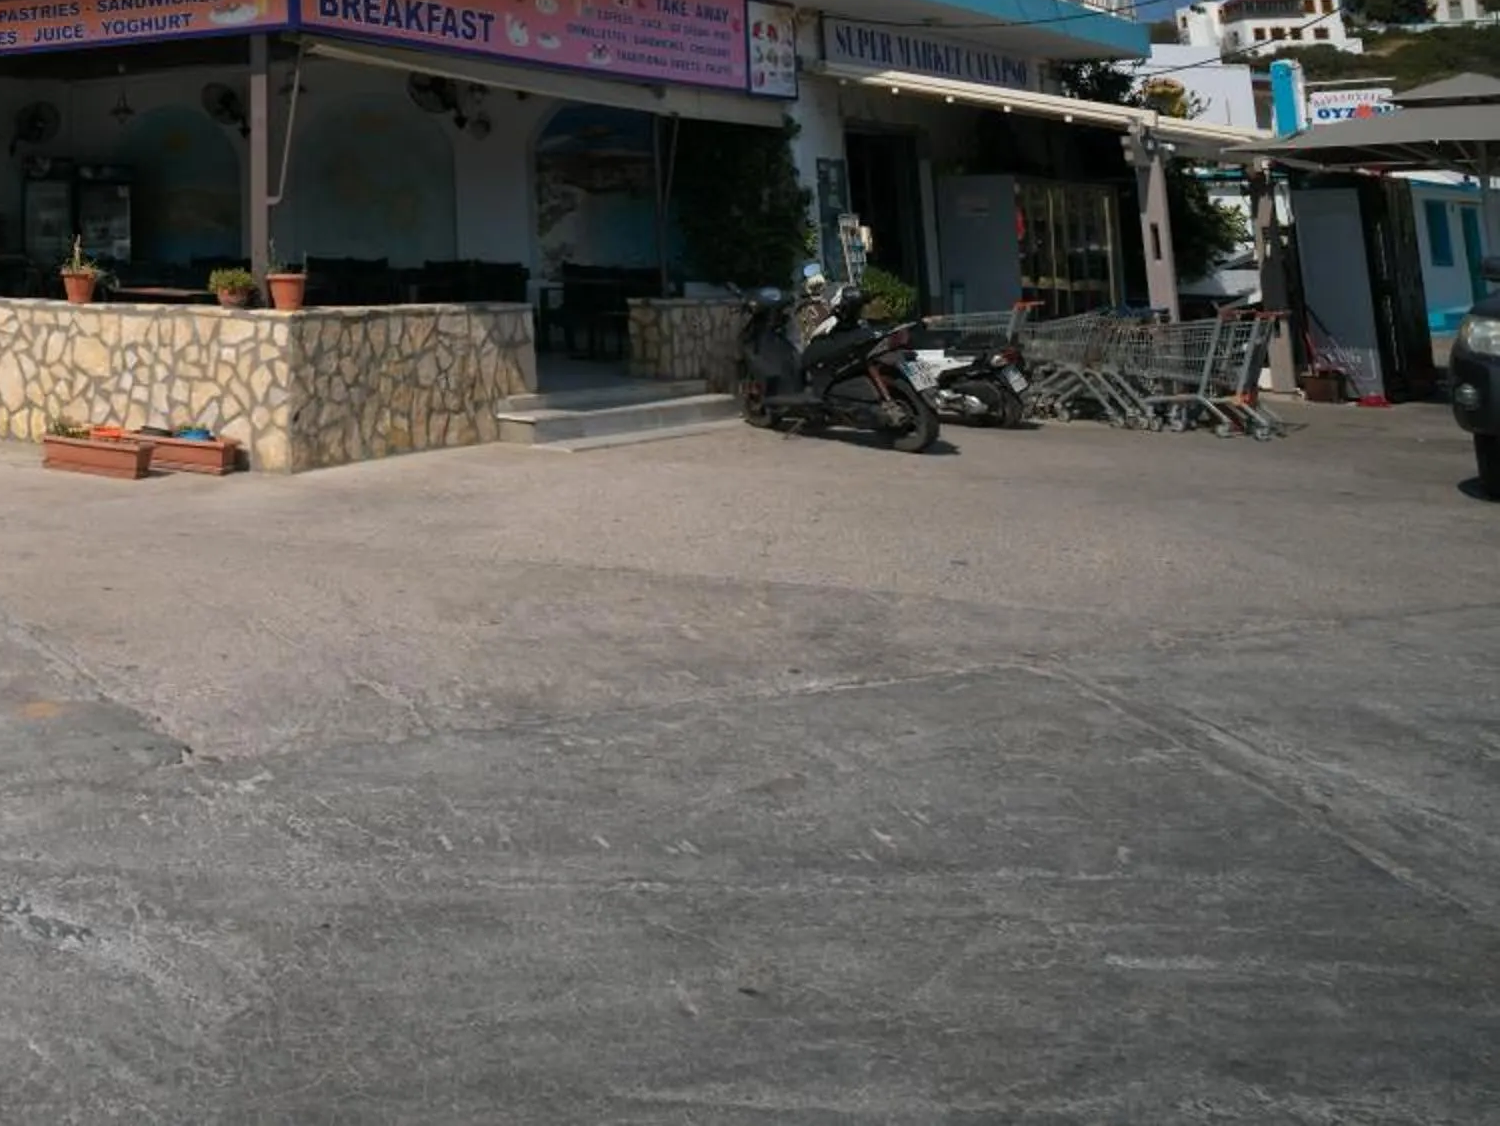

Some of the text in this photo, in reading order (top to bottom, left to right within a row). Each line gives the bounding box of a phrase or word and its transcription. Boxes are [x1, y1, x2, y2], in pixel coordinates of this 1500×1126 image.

[33, 25, 84, 43] JUICE
[101, 12, 194, 35] YOGHURT
[695, 4, 729, 24] AWAY
[834, 24, 893, 65] SUPER
[897, 35, 962, 77] MARKET
